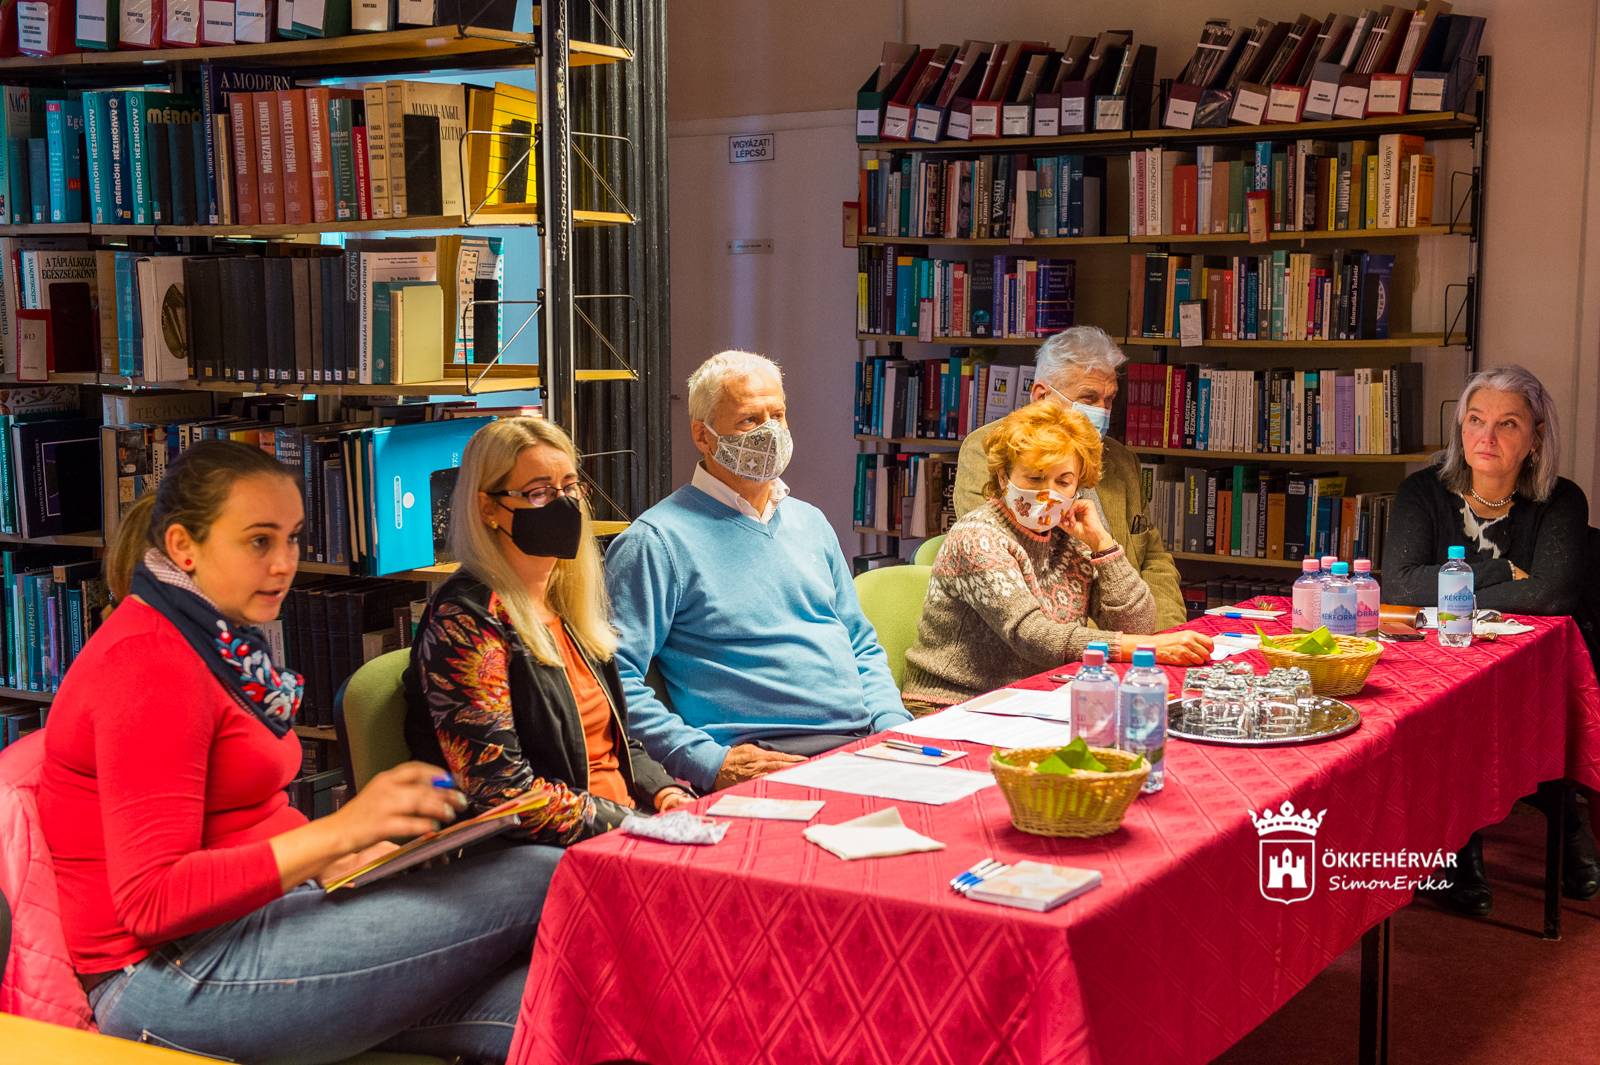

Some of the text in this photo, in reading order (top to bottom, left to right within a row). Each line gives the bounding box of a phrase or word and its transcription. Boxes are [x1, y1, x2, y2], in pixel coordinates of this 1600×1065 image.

[220, 73, 290, 91] A MODERN
[233, 102, 245, 137] LEXIKON
[258, 101, 270, 136] LEXIKON
[282, 100, 294, 135] LEXIKON
[309, 97, 321, 127] LEXIKON
[89, 108, 98, 160] KÉZIKÖNYV
[111, 109, 120, 162] KÉZIKÖNYV
[132, 108, 141, 159] KÉZIKÖNYV
[732, 138, 770, 148] VIGYÁZAT!
[735, 148, 767, 158] LÉPCSŐ
[92, 162, 101, 203] MÉRNÖKI
[114, 163, 122, 205] MÉRNÖKI
[134, 162, 143, 204] MÉRNÖKI
[993, 180, 1003, 218] VASÚTI
[1040, 188, 1053, 198] IAS
[1381, 145, 1393, 218] Papíripari kézikönyv
[46, 258, 51, 268] A
[350, 251, 358, 301] СЛОВАРЬ
[24, 333, 36, 341] 613
[28, 603, 36, 648] AUTIZMUS
